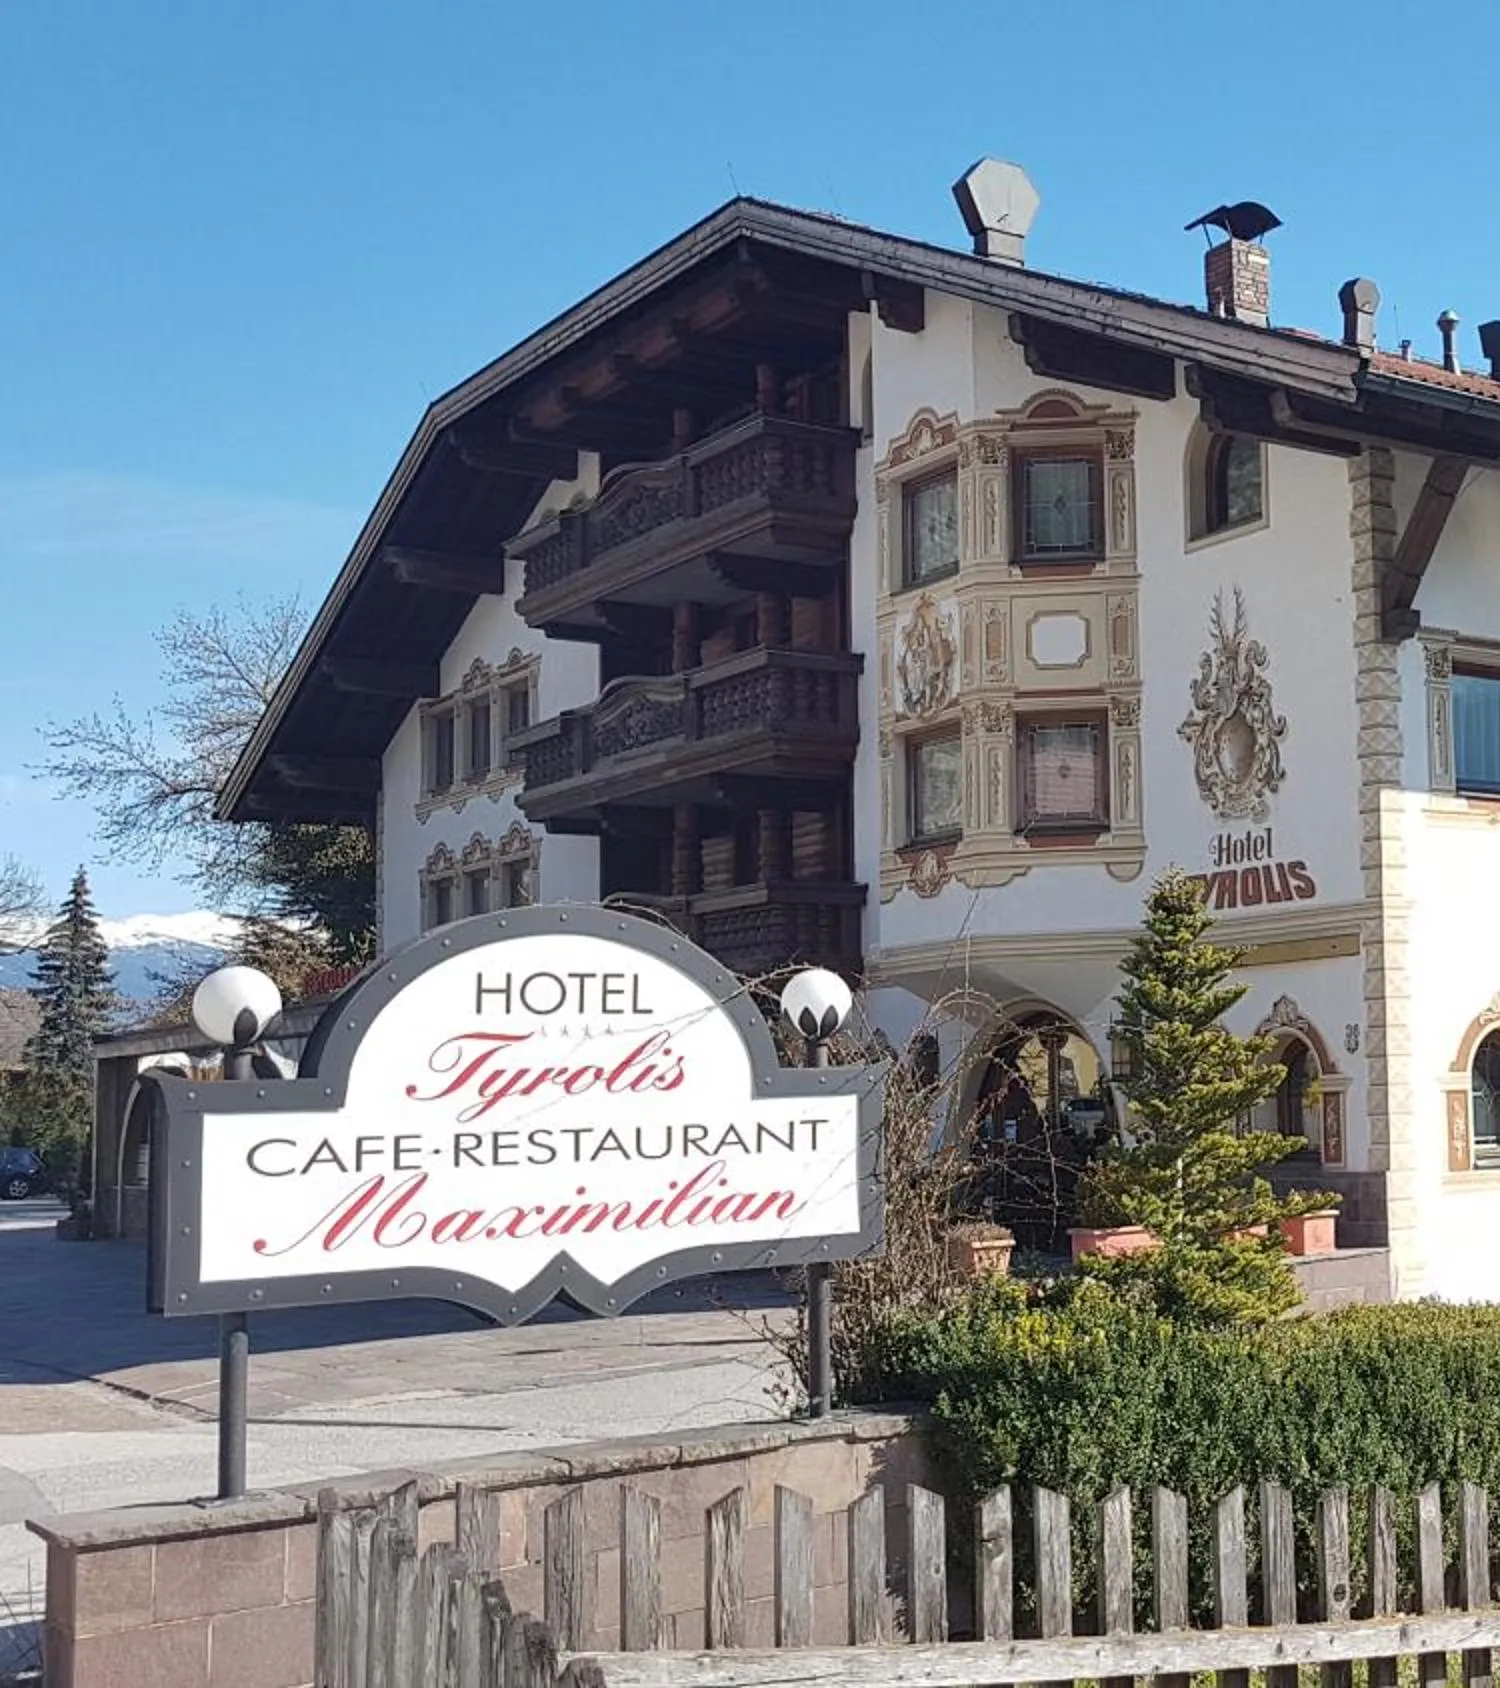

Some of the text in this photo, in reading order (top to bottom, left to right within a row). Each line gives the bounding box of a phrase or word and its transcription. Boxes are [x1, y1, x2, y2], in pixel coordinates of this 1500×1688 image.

[1209, 828, 1273, 867] Hotel
[1183, 860, 1317, 910] YROLIS
[475, 971, 654, 1015] HOTEL
[405, 1029, 685, 1124] Tyrolis
[252, 1159, 810, 1257] Maximilian
